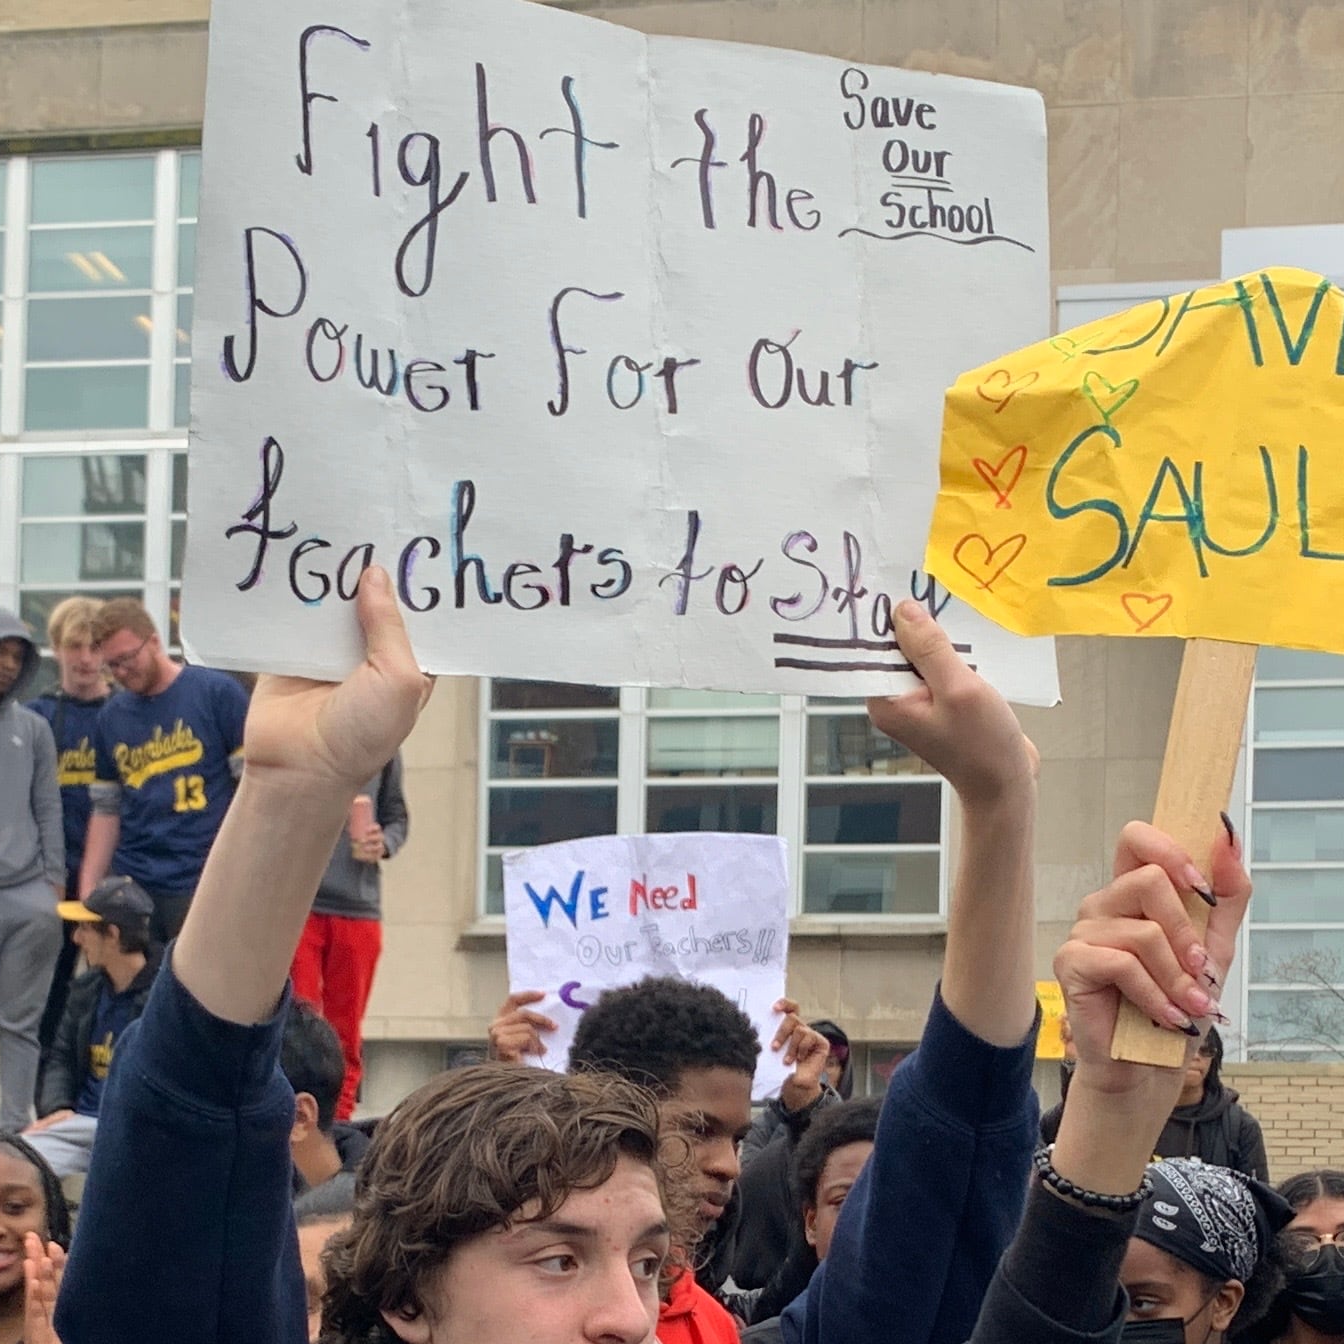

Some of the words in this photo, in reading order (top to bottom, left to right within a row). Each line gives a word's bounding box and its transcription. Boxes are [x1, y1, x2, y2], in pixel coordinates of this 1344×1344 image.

[840, 67, 937, 130] Save
[296, 24, 620, 298] Fight
[670, 107, 823, 231] the
[882, 139, 953, 178] Our
[879, 189, 995, 235] School
[222, 226, 497, 413] Power
[748, 328, 880, 410] Our
[659, 510, 764, 617] to
[173, 775, 207, 812] 13
[629, 873, 698, 916] Need
[577, 934, 638, 967] Our
